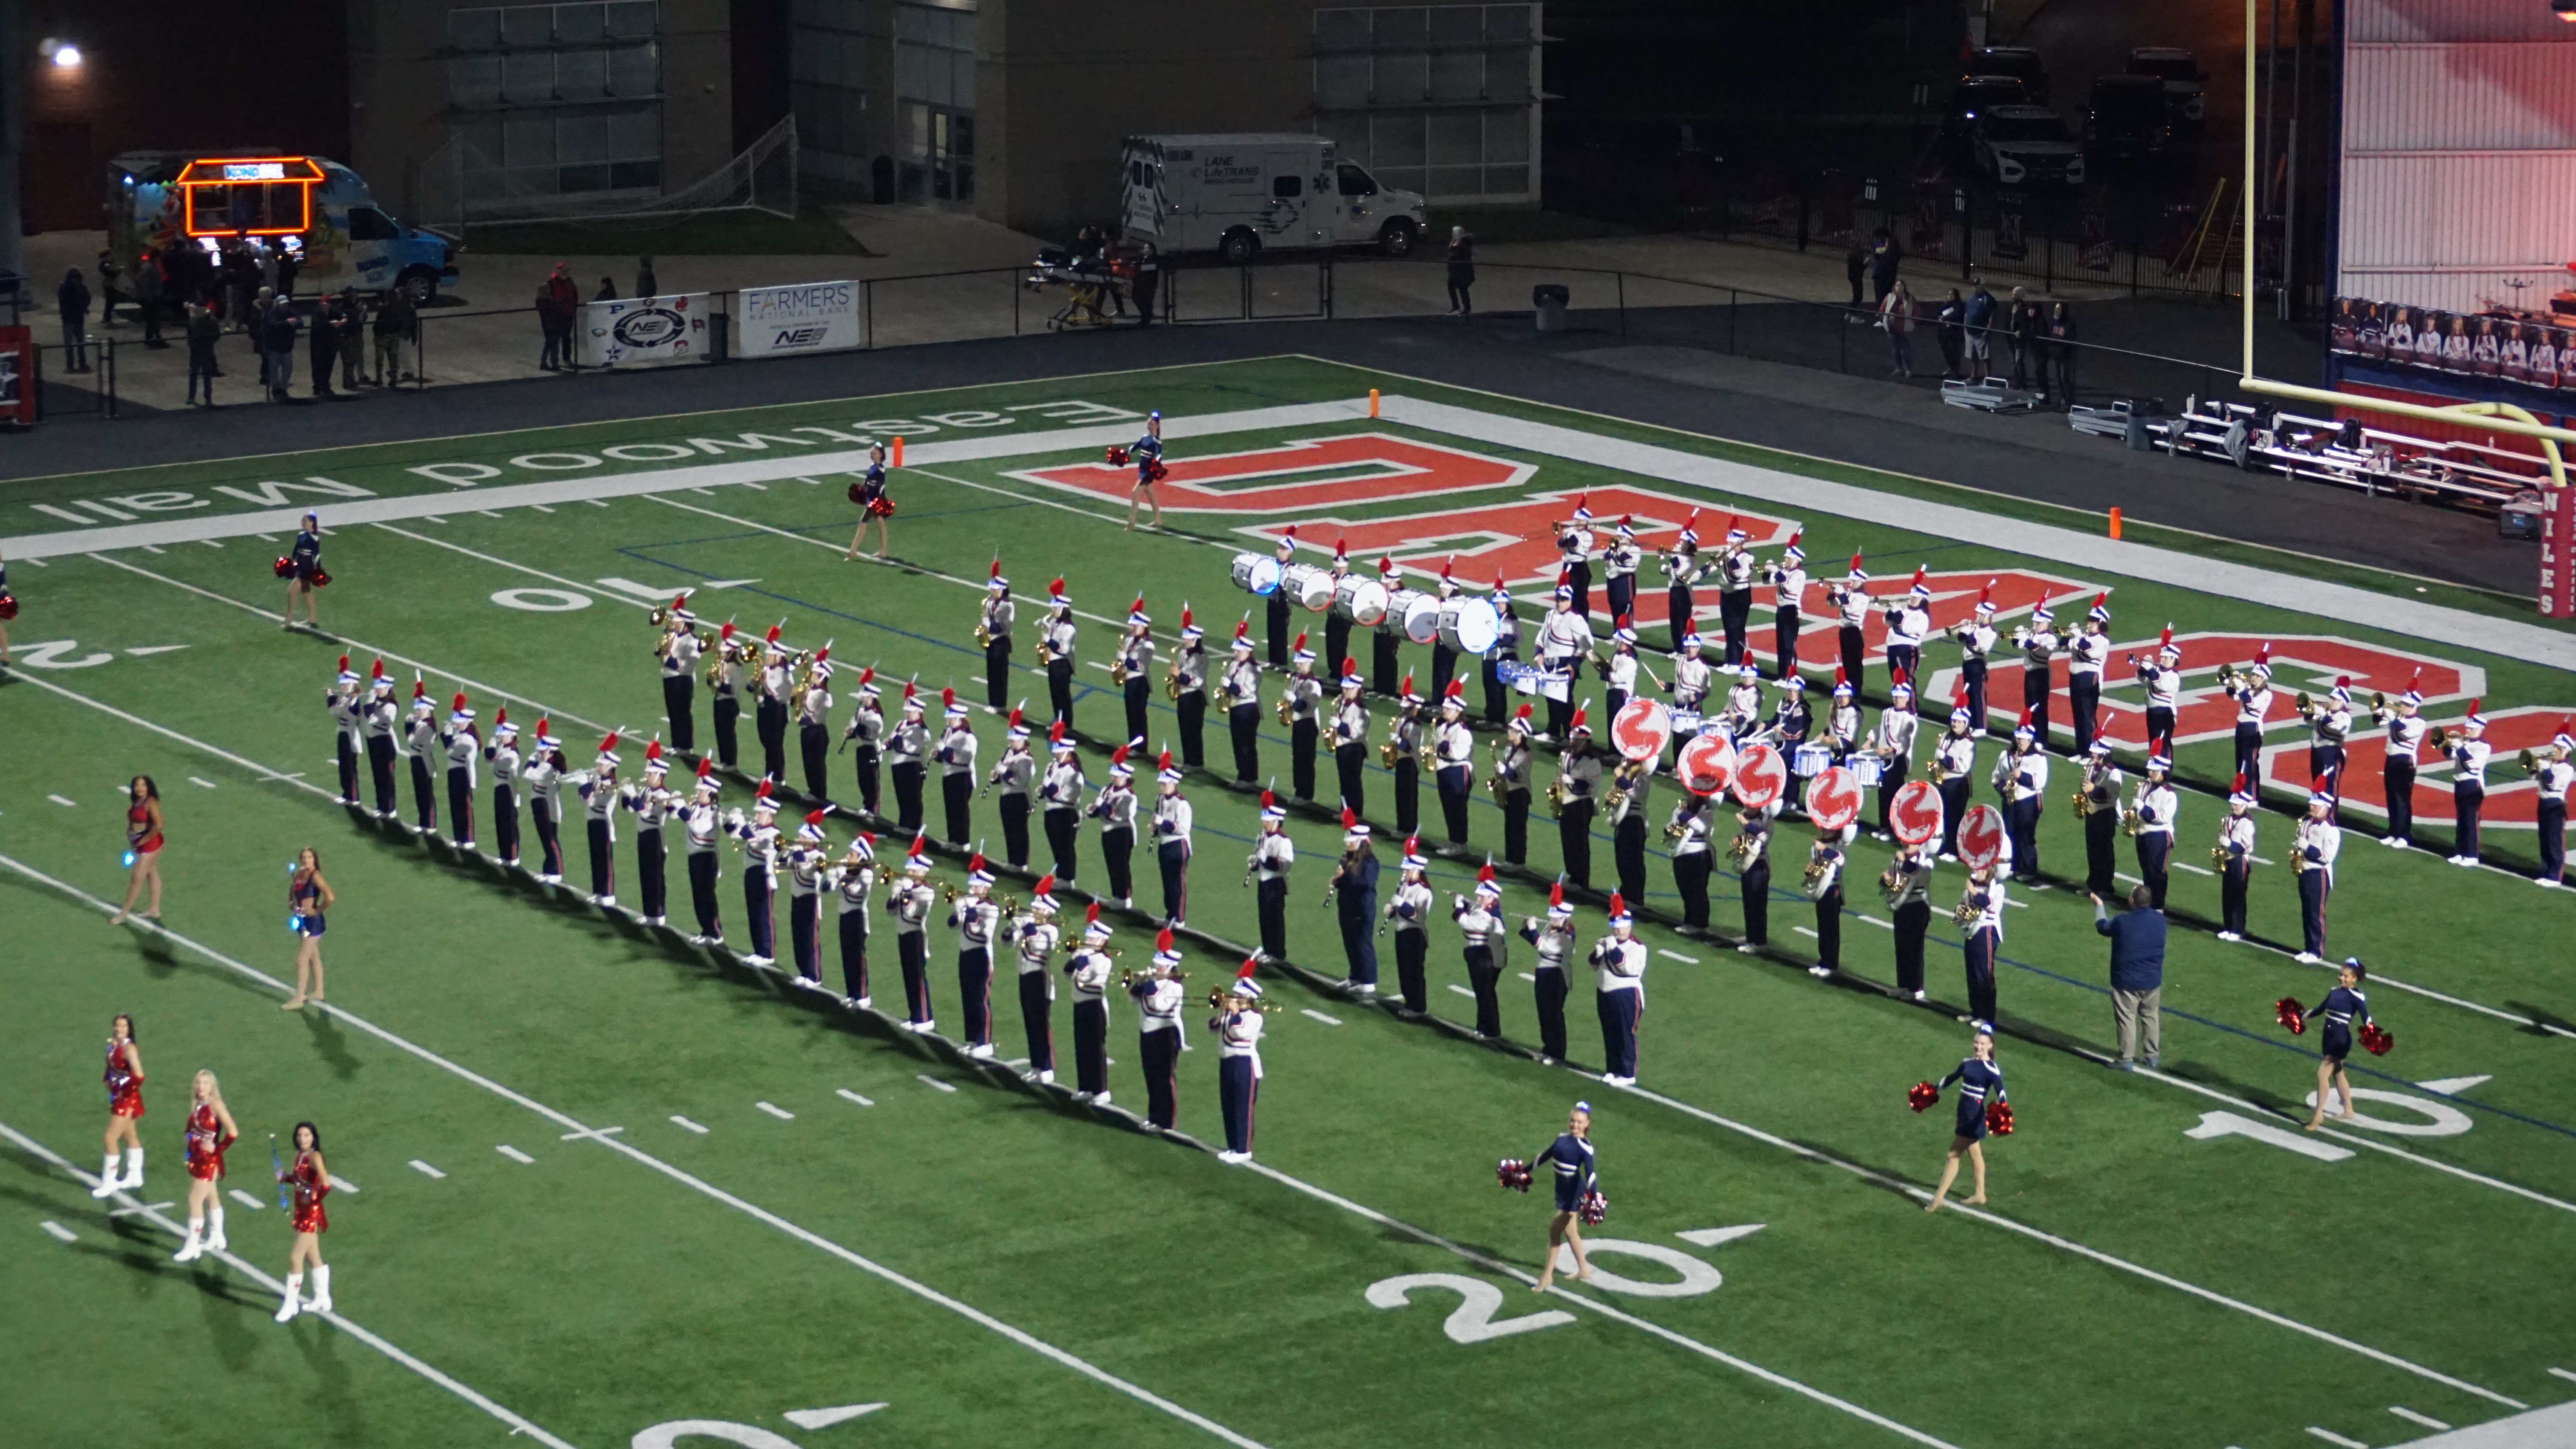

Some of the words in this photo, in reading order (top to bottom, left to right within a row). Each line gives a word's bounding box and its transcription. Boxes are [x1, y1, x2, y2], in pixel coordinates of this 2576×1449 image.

[1205, 156, 1234, 166] LANE
[609, 305, 625, 314] P
[750, 286, 850, 312] FARMERS
[750, 309, 810, 321] NATIONAL
[819, 306, 850, 316] BANK
[407, 399, 1149, 488] Eastwood
[29, 476, 378, 524] Mall
[2540, 491, 2558, 614] NILES
[2183, 1087, 2474, 1162] 10
[1364, 1237, 1722, 1344] 20
